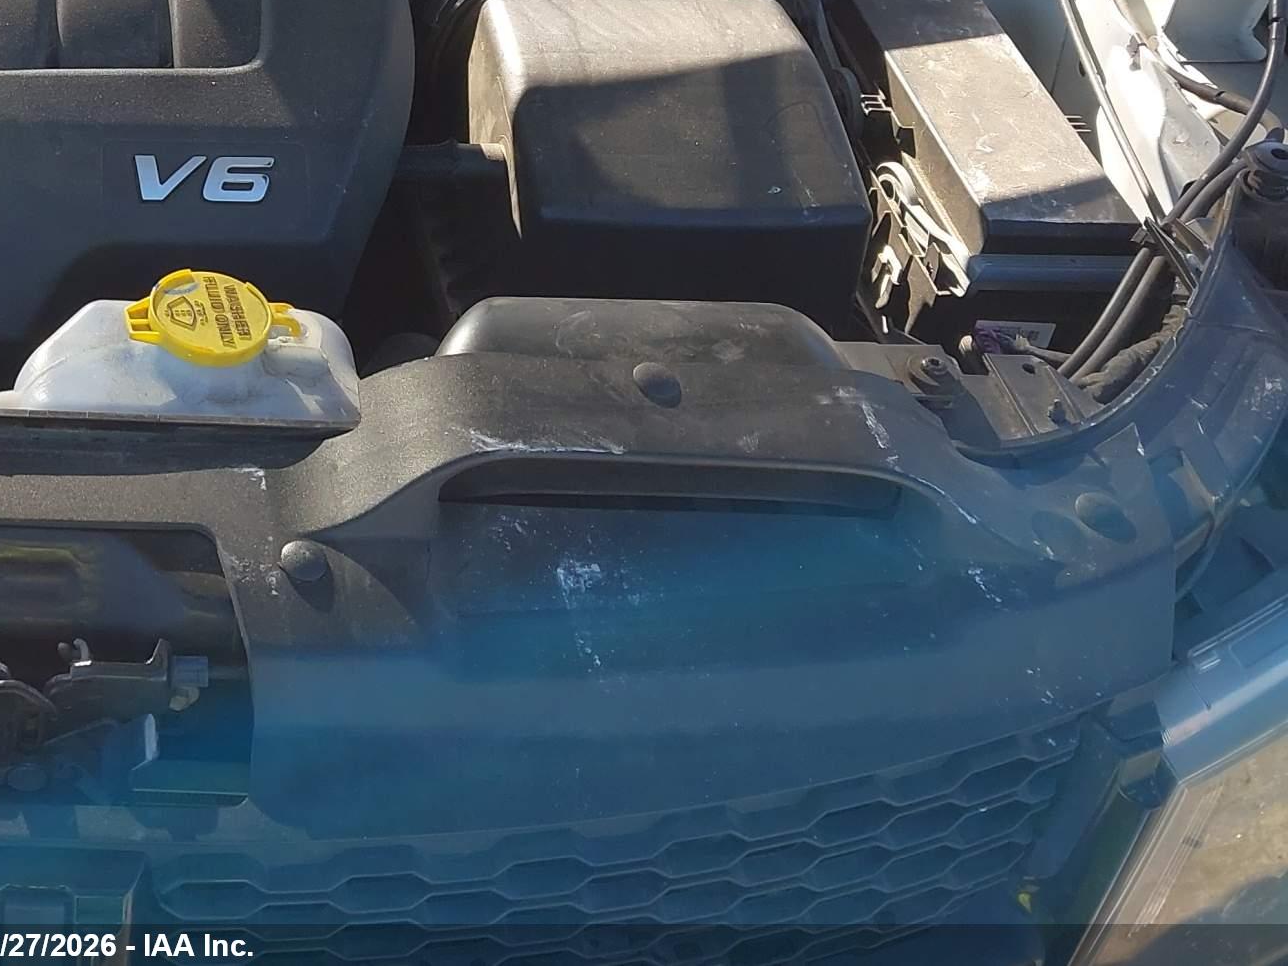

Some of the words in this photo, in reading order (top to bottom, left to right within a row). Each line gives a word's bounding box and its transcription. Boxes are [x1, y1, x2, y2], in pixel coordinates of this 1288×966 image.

[134, 154, 275, 202] V6
[202, 276, 225, 313] FLUID
[214, 313, 238, 349] ONLY
[223, 284, 253, 341] WASHER
